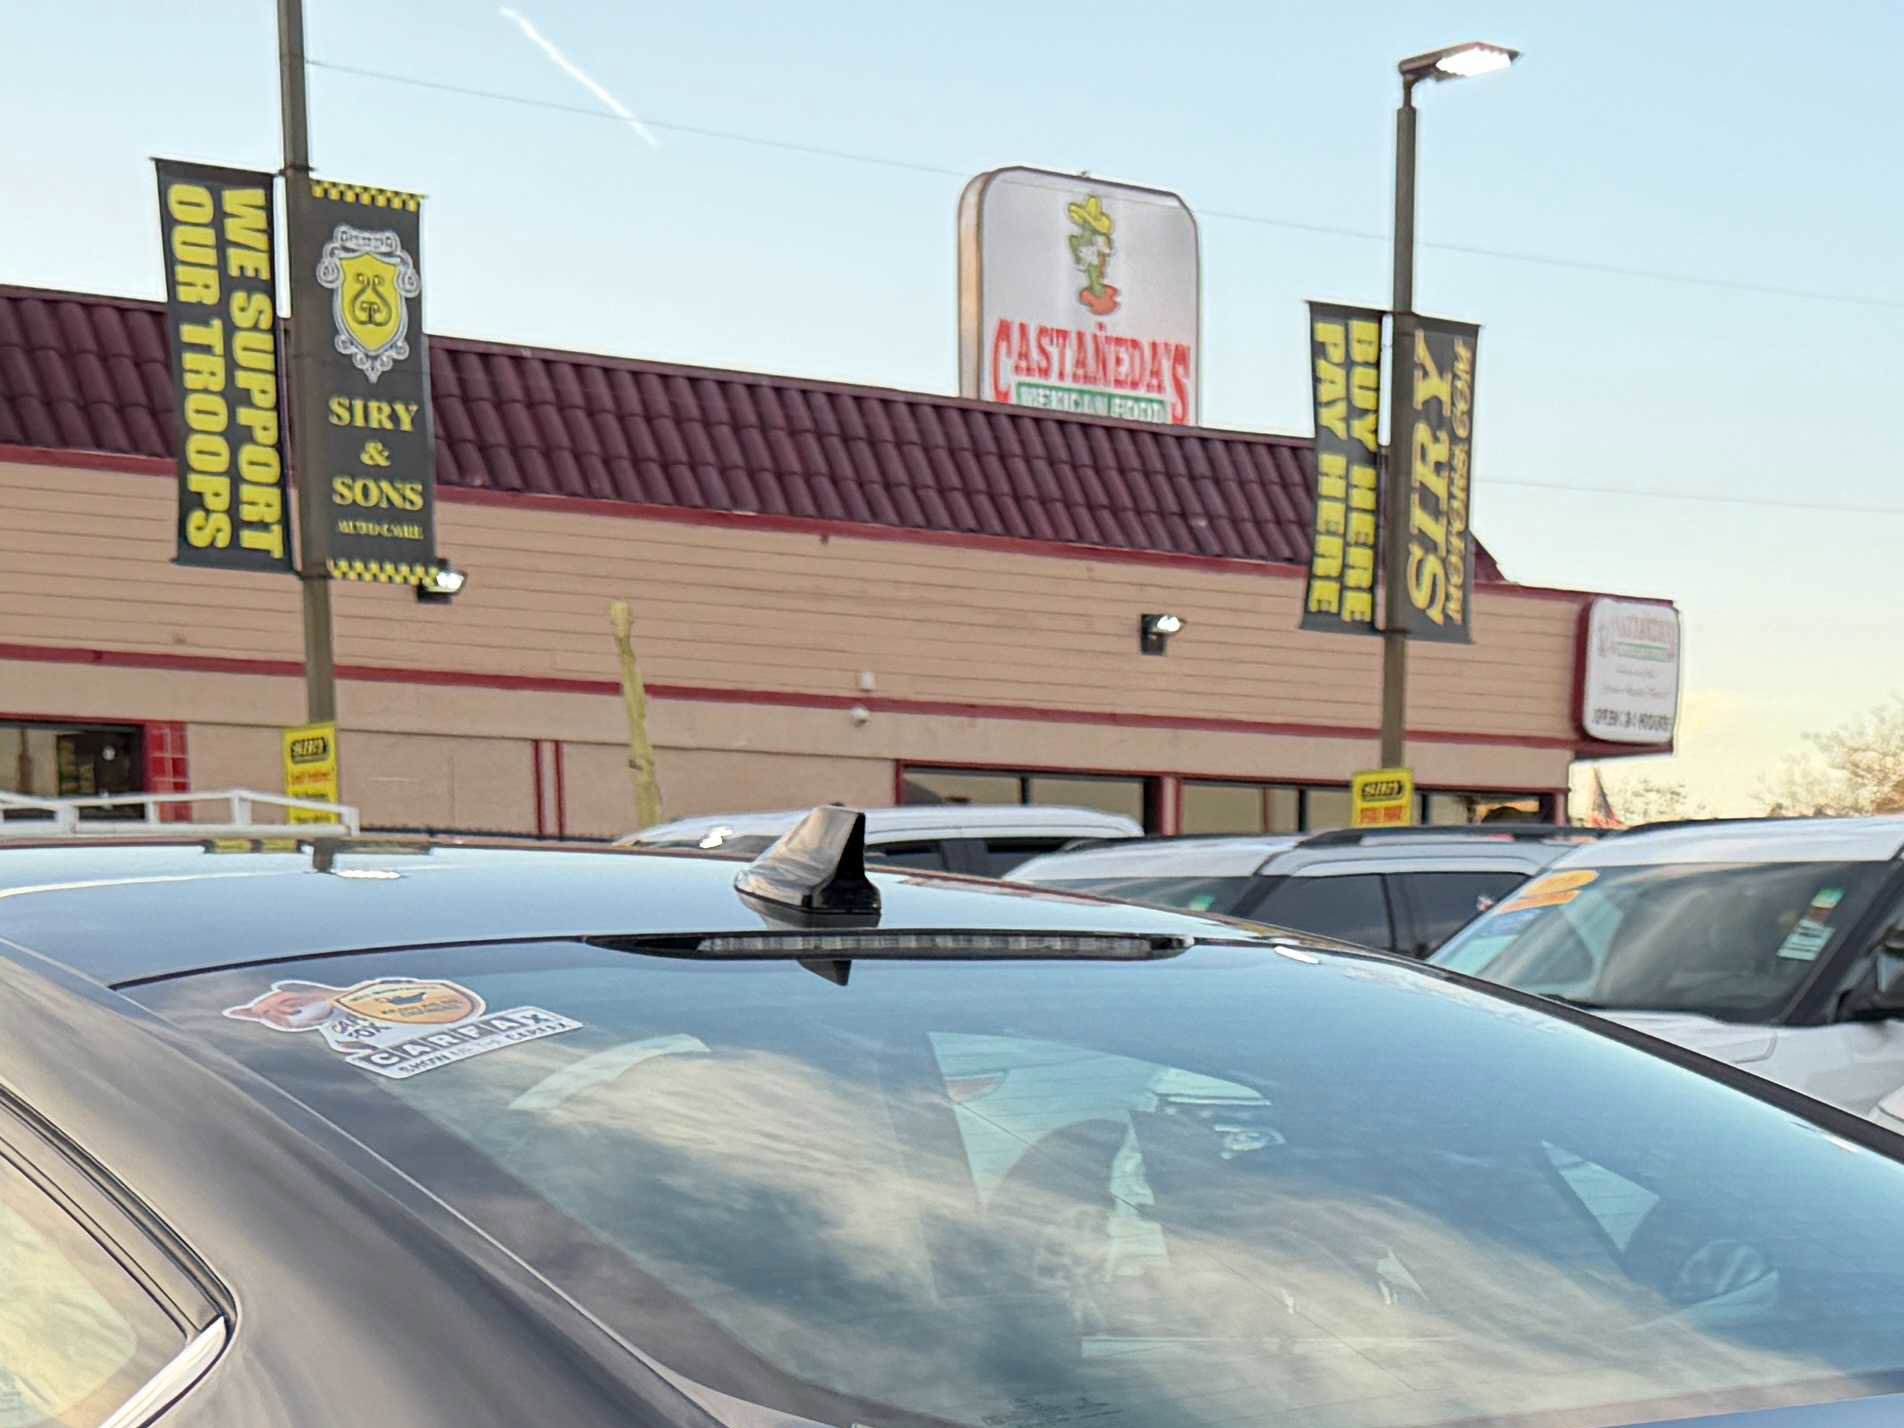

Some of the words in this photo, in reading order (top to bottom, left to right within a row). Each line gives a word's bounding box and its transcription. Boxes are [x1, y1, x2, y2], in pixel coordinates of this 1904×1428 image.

[167, 184, 221, 306] OUR
[221, 188, 271, 281] WE
[179, 318, 232, 550] TROOPS
[228, 292, 285, 560] SUPPORT
[328, 395, 419, 432] SIRY
[1314, 323, 1348, 440] PAY
[1349, 320, 1379, 453] BUY
[332, 475, 424, 511] SONS
[360, 440, 390, 467] &
[1407, 329, 1452, 625] SIRY
[1308, 454, 1346, 613] HERE
[1341, 465, 1377, 622] HERE
[369, 1013, 550, 1066] CARFAX
